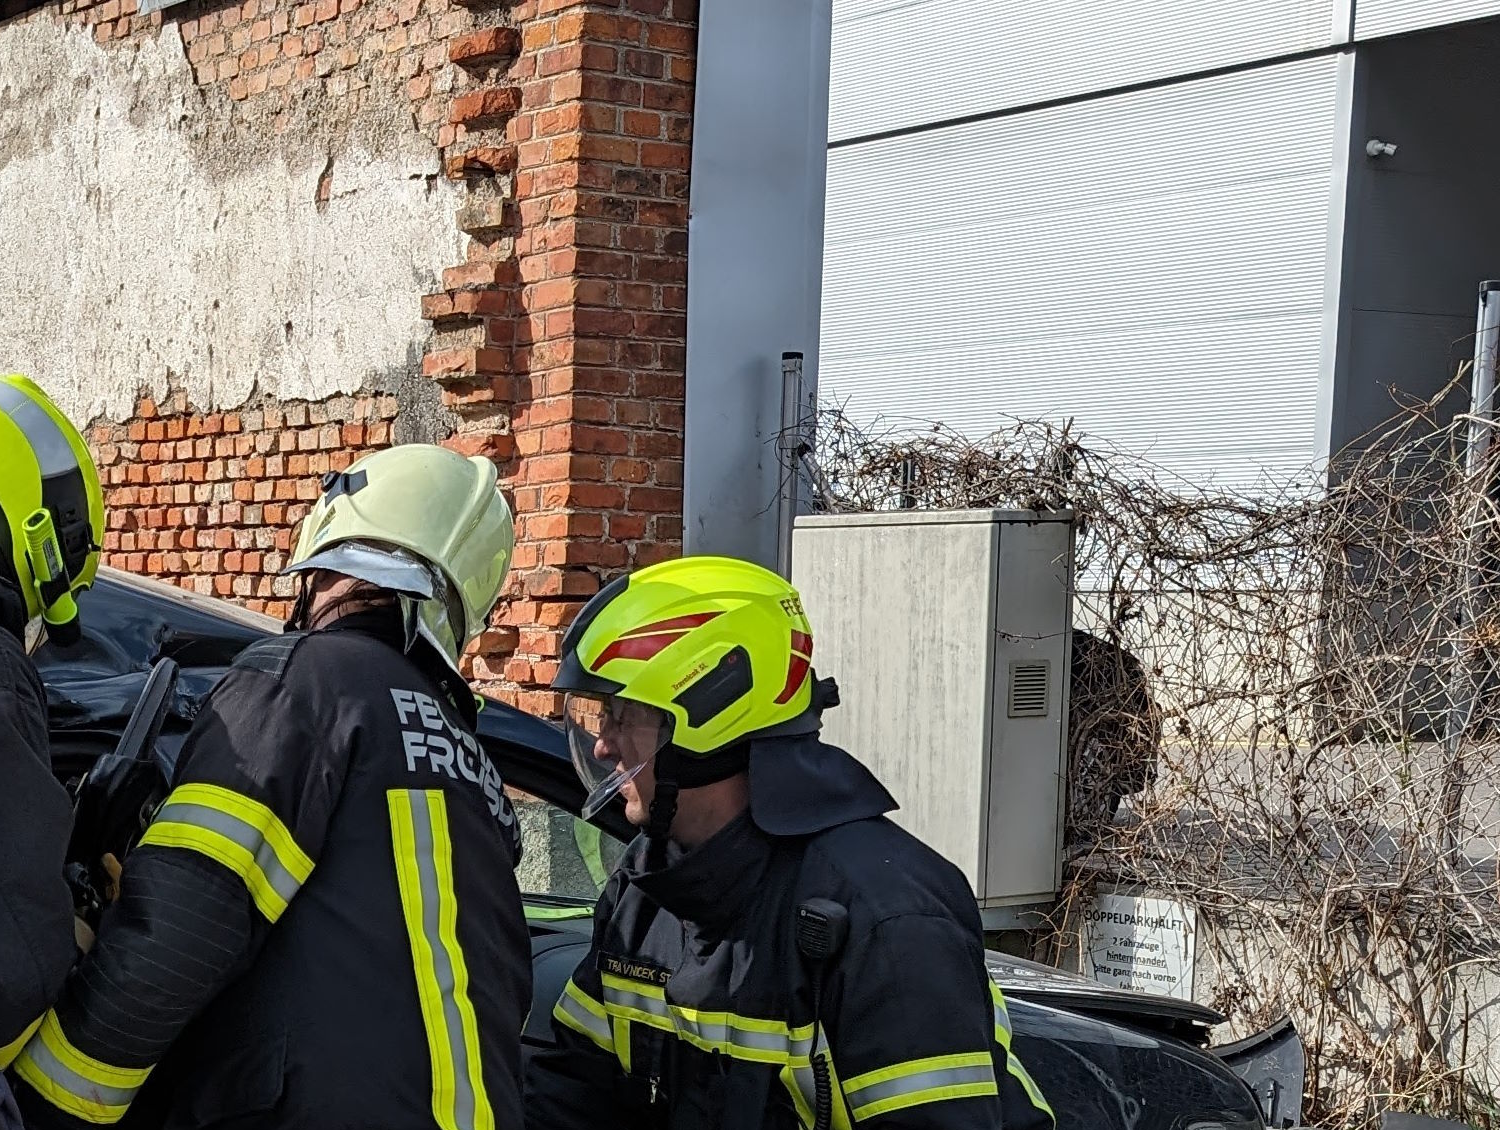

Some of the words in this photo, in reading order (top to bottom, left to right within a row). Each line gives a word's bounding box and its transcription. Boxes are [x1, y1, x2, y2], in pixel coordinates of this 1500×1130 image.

[1084, 909, 1183, 931] DOPPELPARKHÄLFT
[1120, 938, 1160, 952] Fahrzeuge
[1112, 966, 1132, 977] ganz
[1132, 970, 1151, 980] nach
[1152, 972, 1177, 983] vorne
